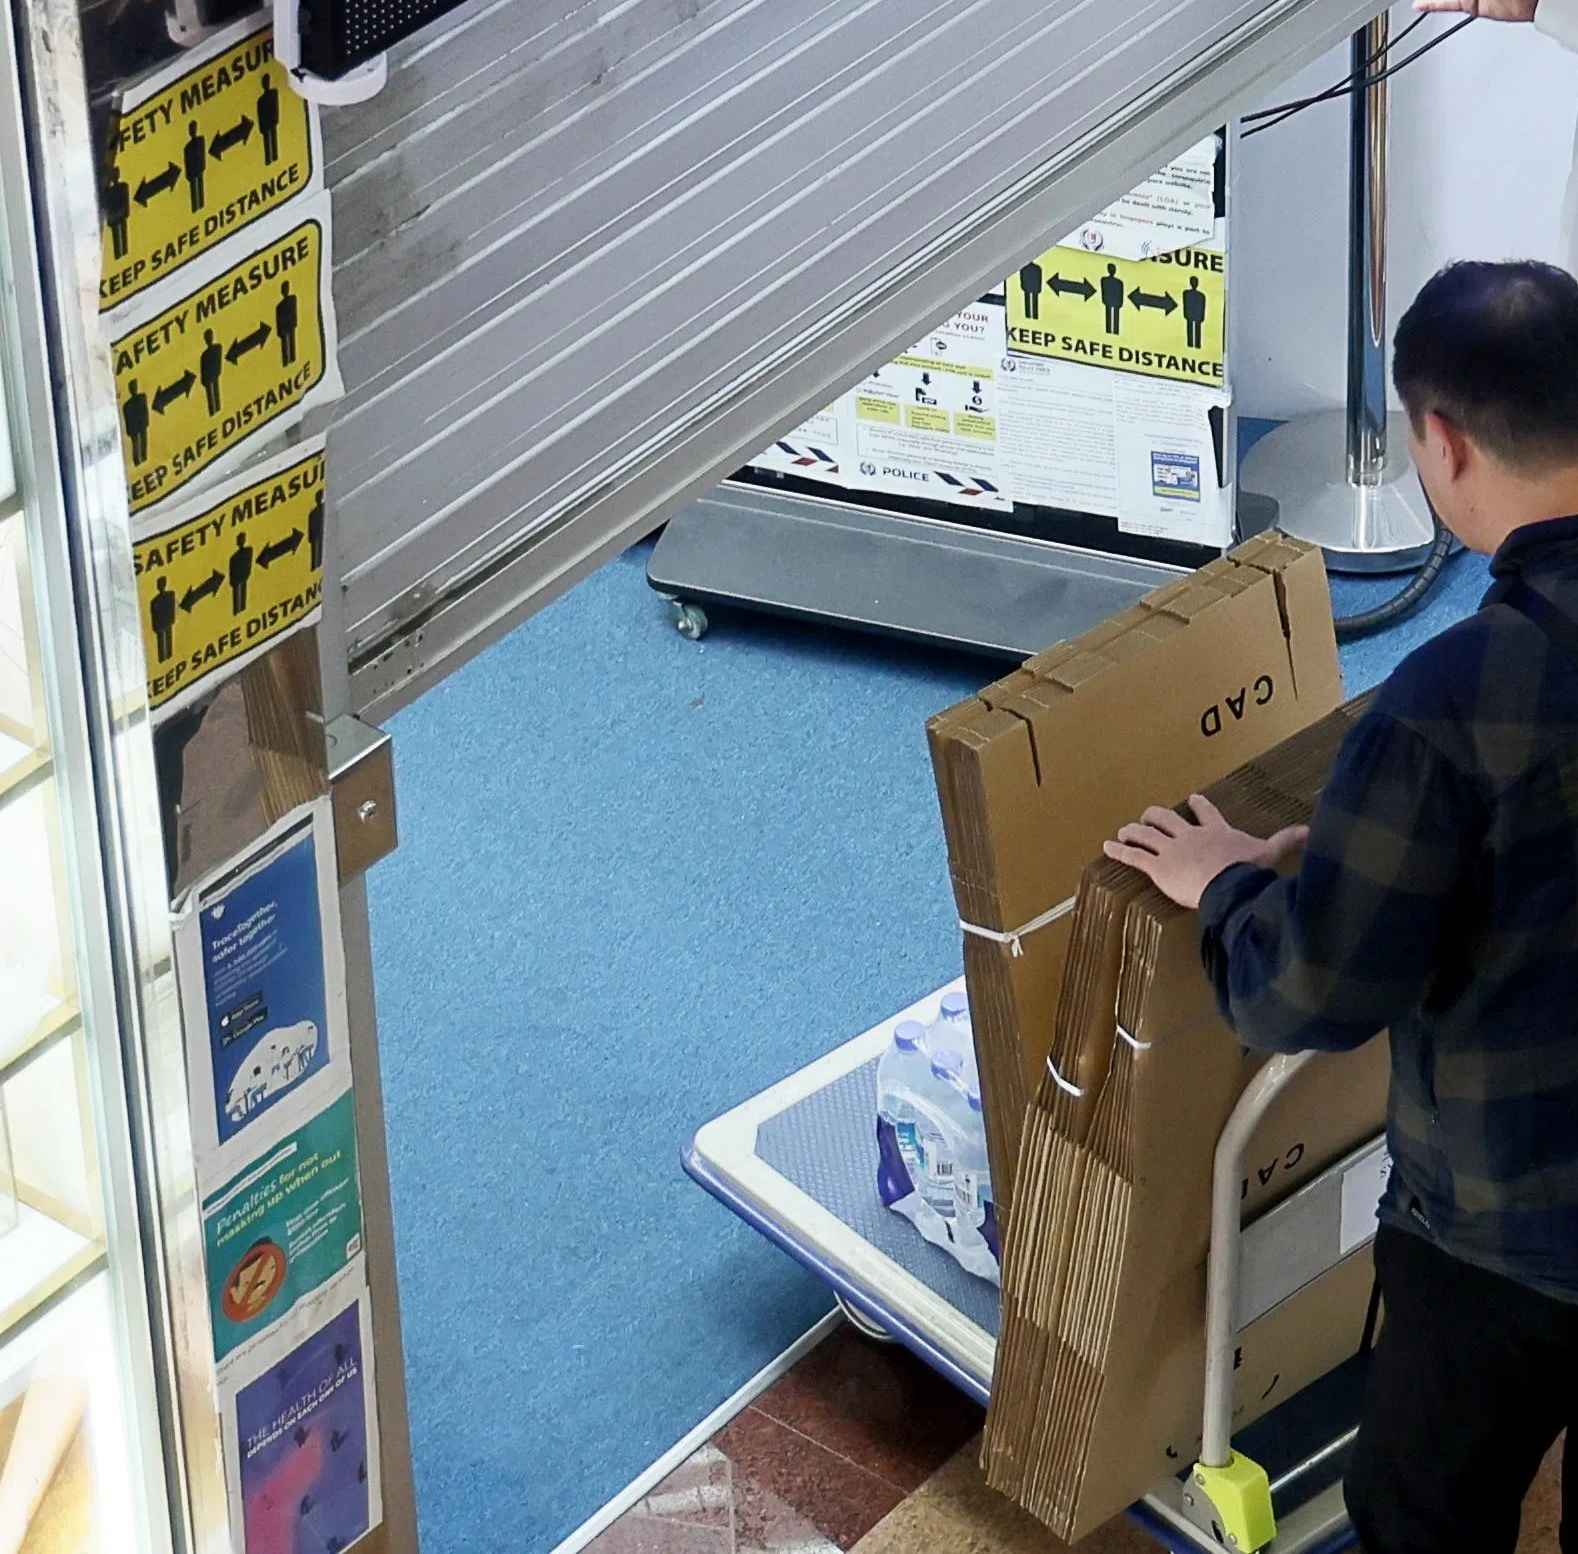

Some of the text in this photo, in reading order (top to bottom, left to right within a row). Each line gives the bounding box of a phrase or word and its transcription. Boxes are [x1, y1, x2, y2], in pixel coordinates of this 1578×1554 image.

[118, 40, 275, 152] FETY MEASUR
[151, 230, 200, 271] SAFE
[203, 163, 301, 237] DISTANCE
[1140, 246, 1224, 274] SURE
[115, 236, 310, 376] AFETY MEASURE
[954, 322, 985, 334] YOU?
[1007, 326, 1225, 378] KEEP SAFE DISTANCE
[129, 362, 312, 503] EEP SAFE DISTANCE
[230, 459, 326, 528] MEASU
[883, 466, 930, 482] POLICE
[148, 659, 188, 699] EEP
[190, 627, 242, 671] SAFE
[1200, 673, 1276, 739] CAD
[238, 913, 276, 946] together
[216, 1152, 320, 1235] Penalties for not
[217, 1149, 342, 1247] masking up when out
[1241, 1142, 1305, 1201] CA
[246, 1357, 359, 1449] THE HEALTH OF ALL
[246, 1428, 284, 1459] DEPENDS
[284, 1417, 297, 1431] ON
[297, 1400, 319, 1421] EACH
